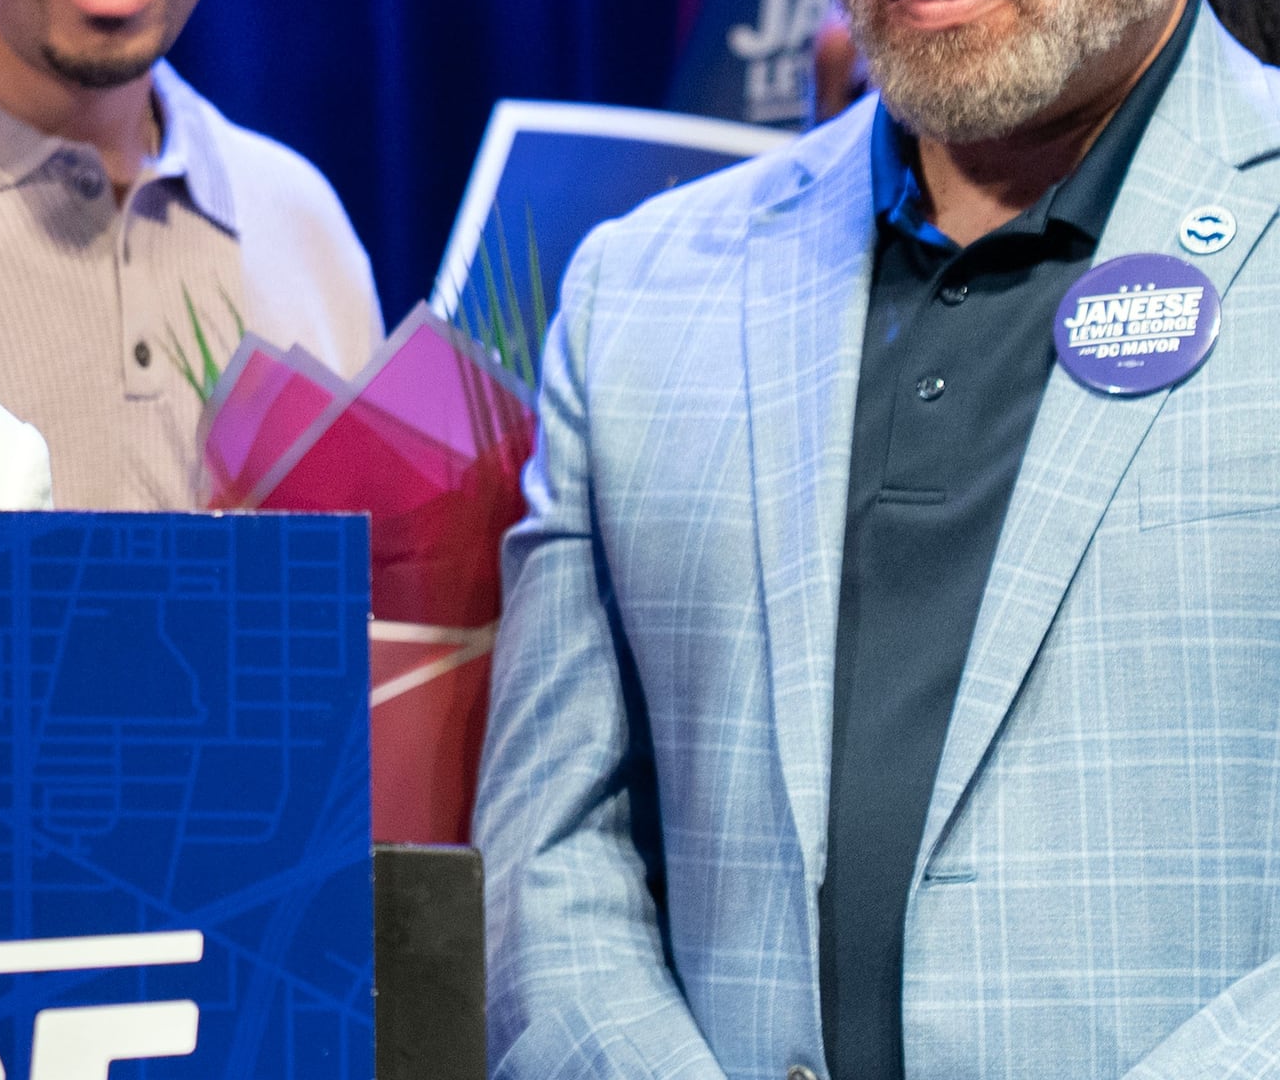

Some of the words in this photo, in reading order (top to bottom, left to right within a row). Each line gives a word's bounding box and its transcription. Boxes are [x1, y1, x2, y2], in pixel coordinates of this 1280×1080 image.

[1064, 293, 1204, 328] JANEESE
[1069, 322, 1123, 342] LEWIS
[1128, 316, 1197, 336] GEORGE
[1096, 342, 1120, 359] DC
[1121, 338, 1180, 357] MAYOR
